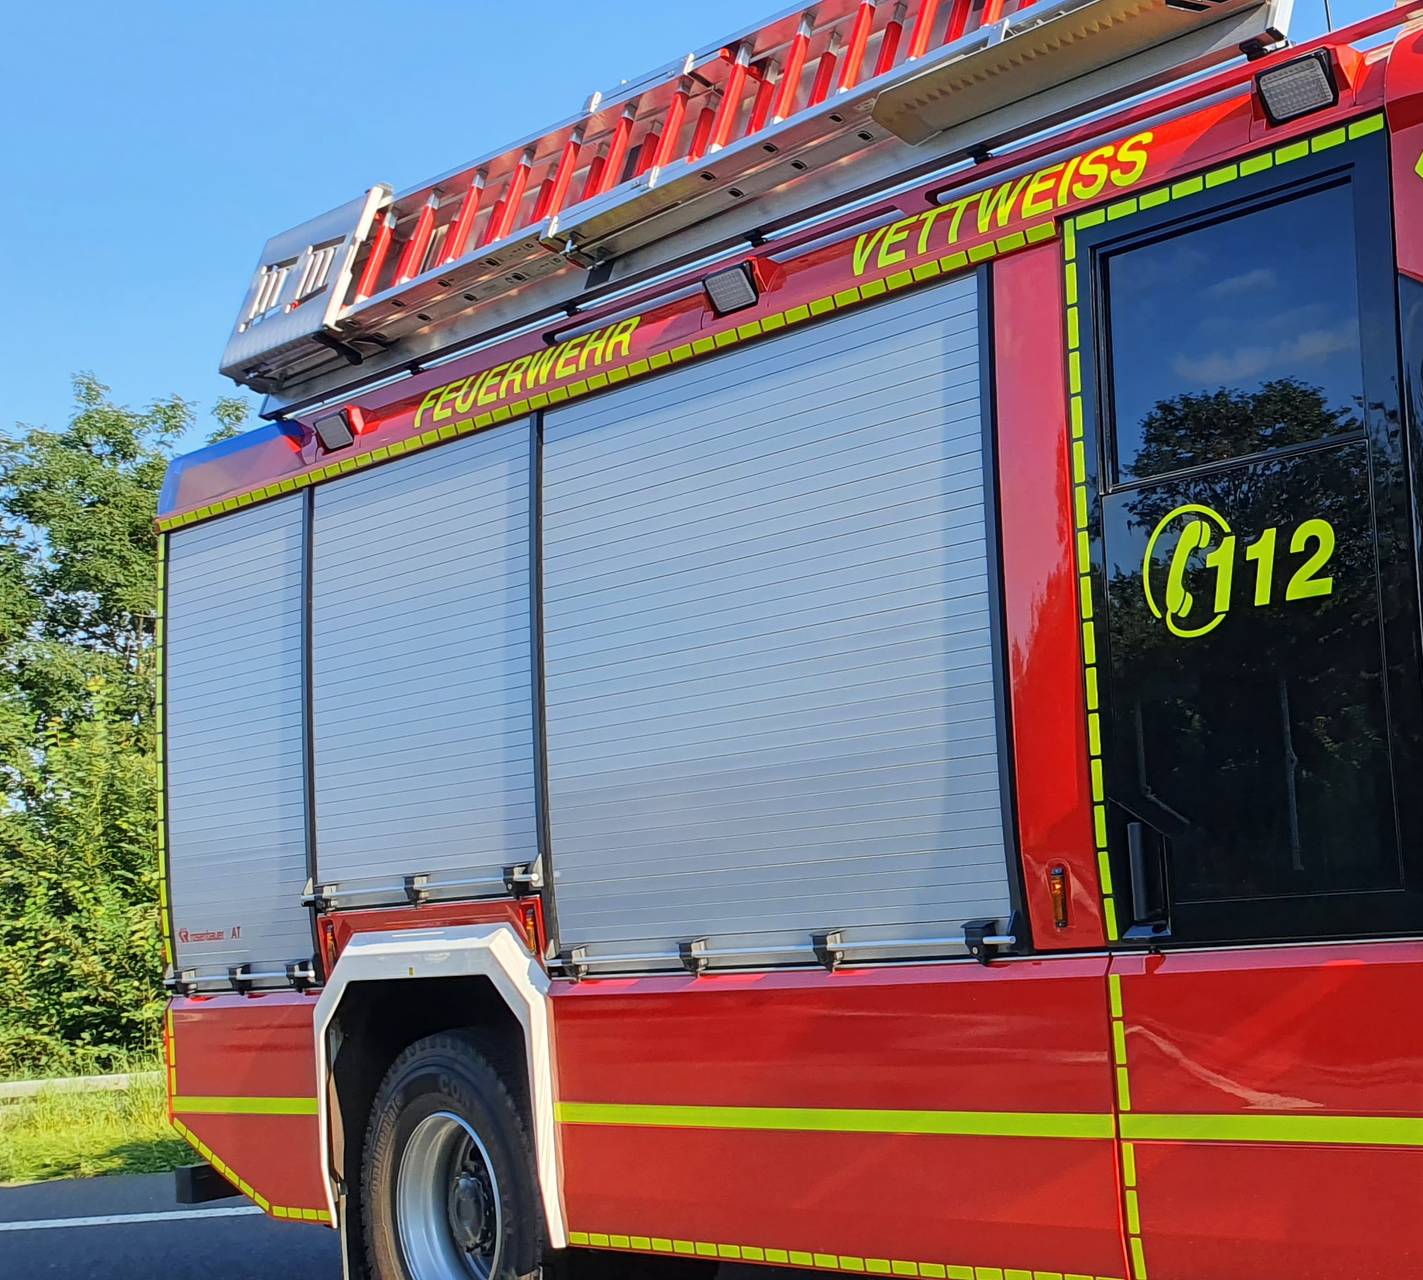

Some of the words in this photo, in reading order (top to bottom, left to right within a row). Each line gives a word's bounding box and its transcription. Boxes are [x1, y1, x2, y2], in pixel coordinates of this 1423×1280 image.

[413, 315, 642, 428] FEUERWEHR
[851, 131, 1154, 277] VETTWEISS
[1204, 517, 1337, 614] 112
